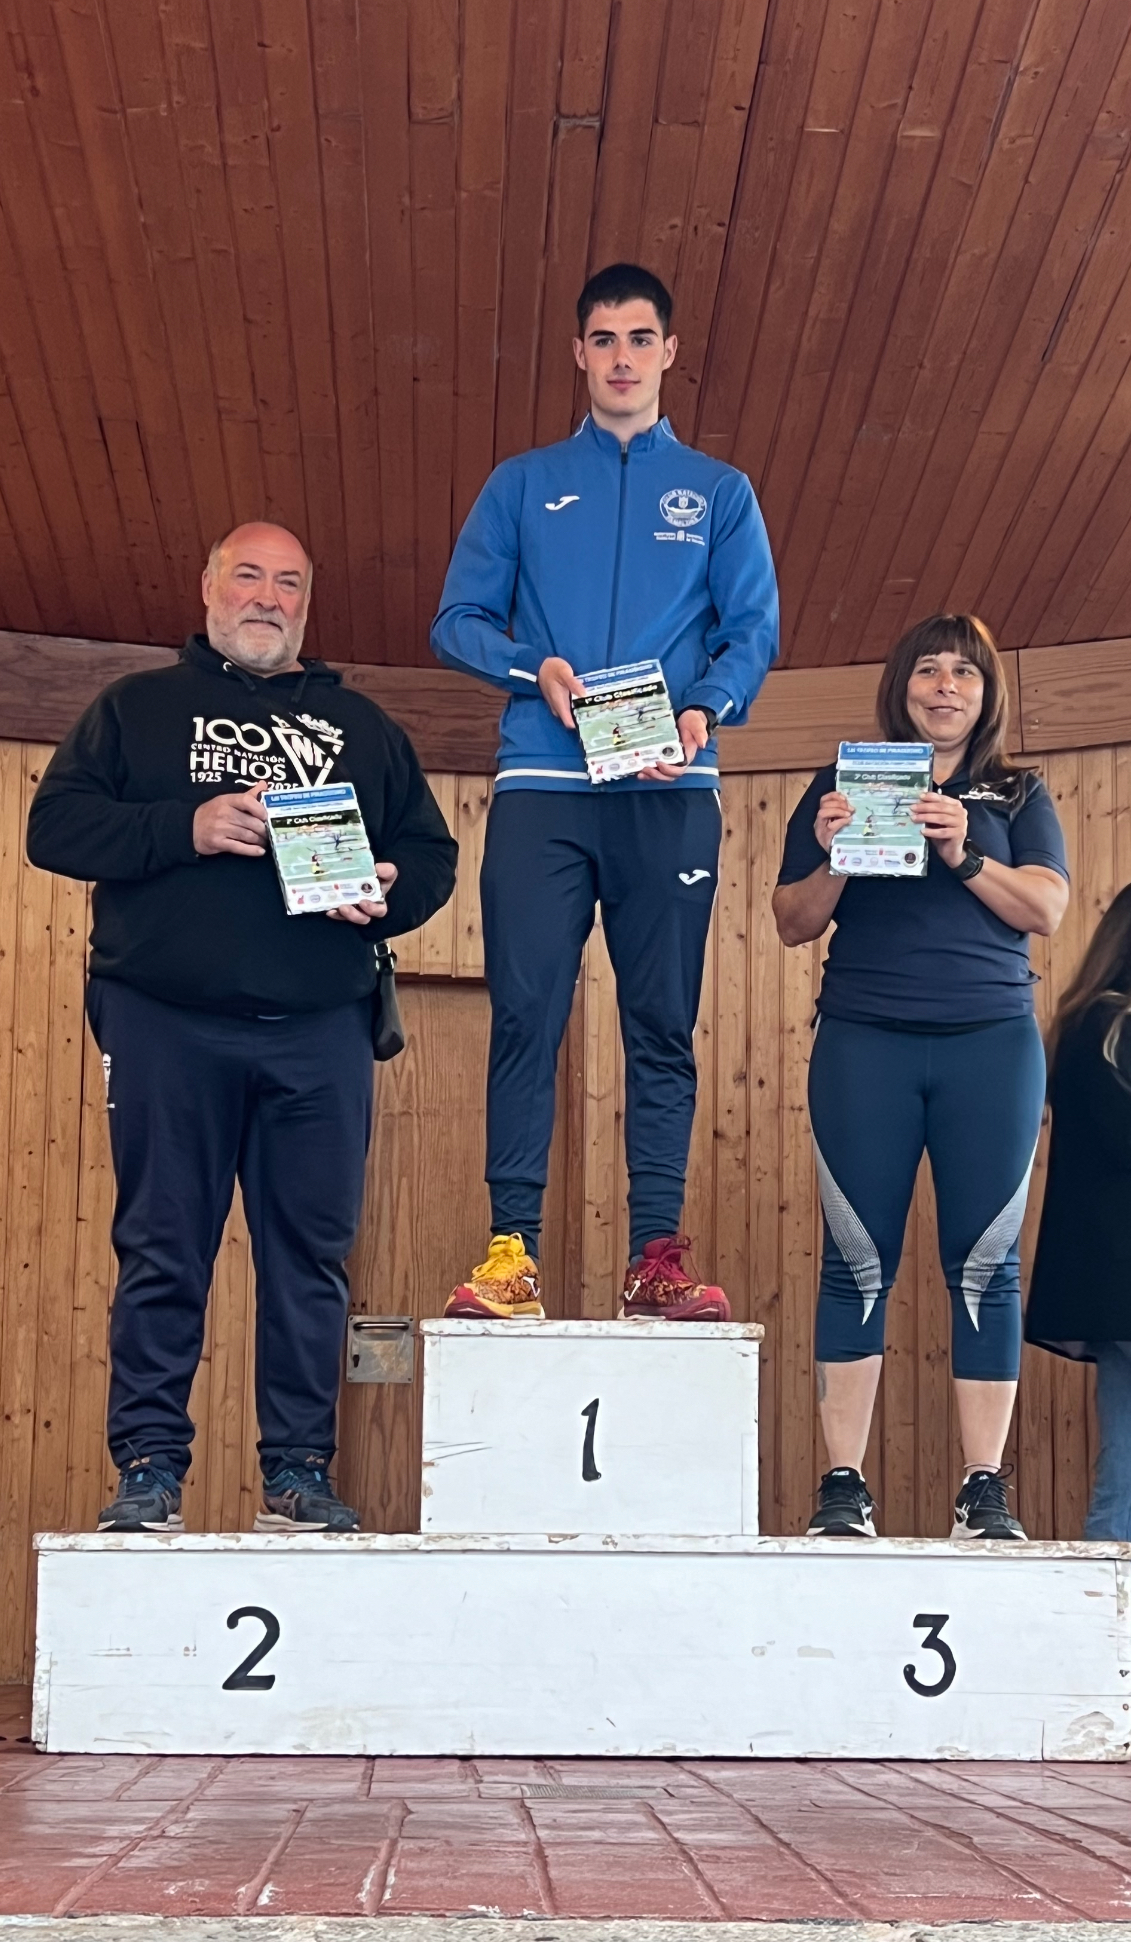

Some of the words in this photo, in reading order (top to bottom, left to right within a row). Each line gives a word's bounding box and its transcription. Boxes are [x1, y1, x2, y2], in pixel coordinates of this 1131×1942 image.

[594, 694, 613, 703] Club
[191, 743, 231, 753] CENTRO
[192, 716, 271, 752] 100
[190, 751, 287, 781] HELIOS
[190, 771, 222, 783] 1925
[581, 1398, 602, 1481] 1
[222, 1607, 281, 1692] 2
[902, 1614, 957, 1698] 3
